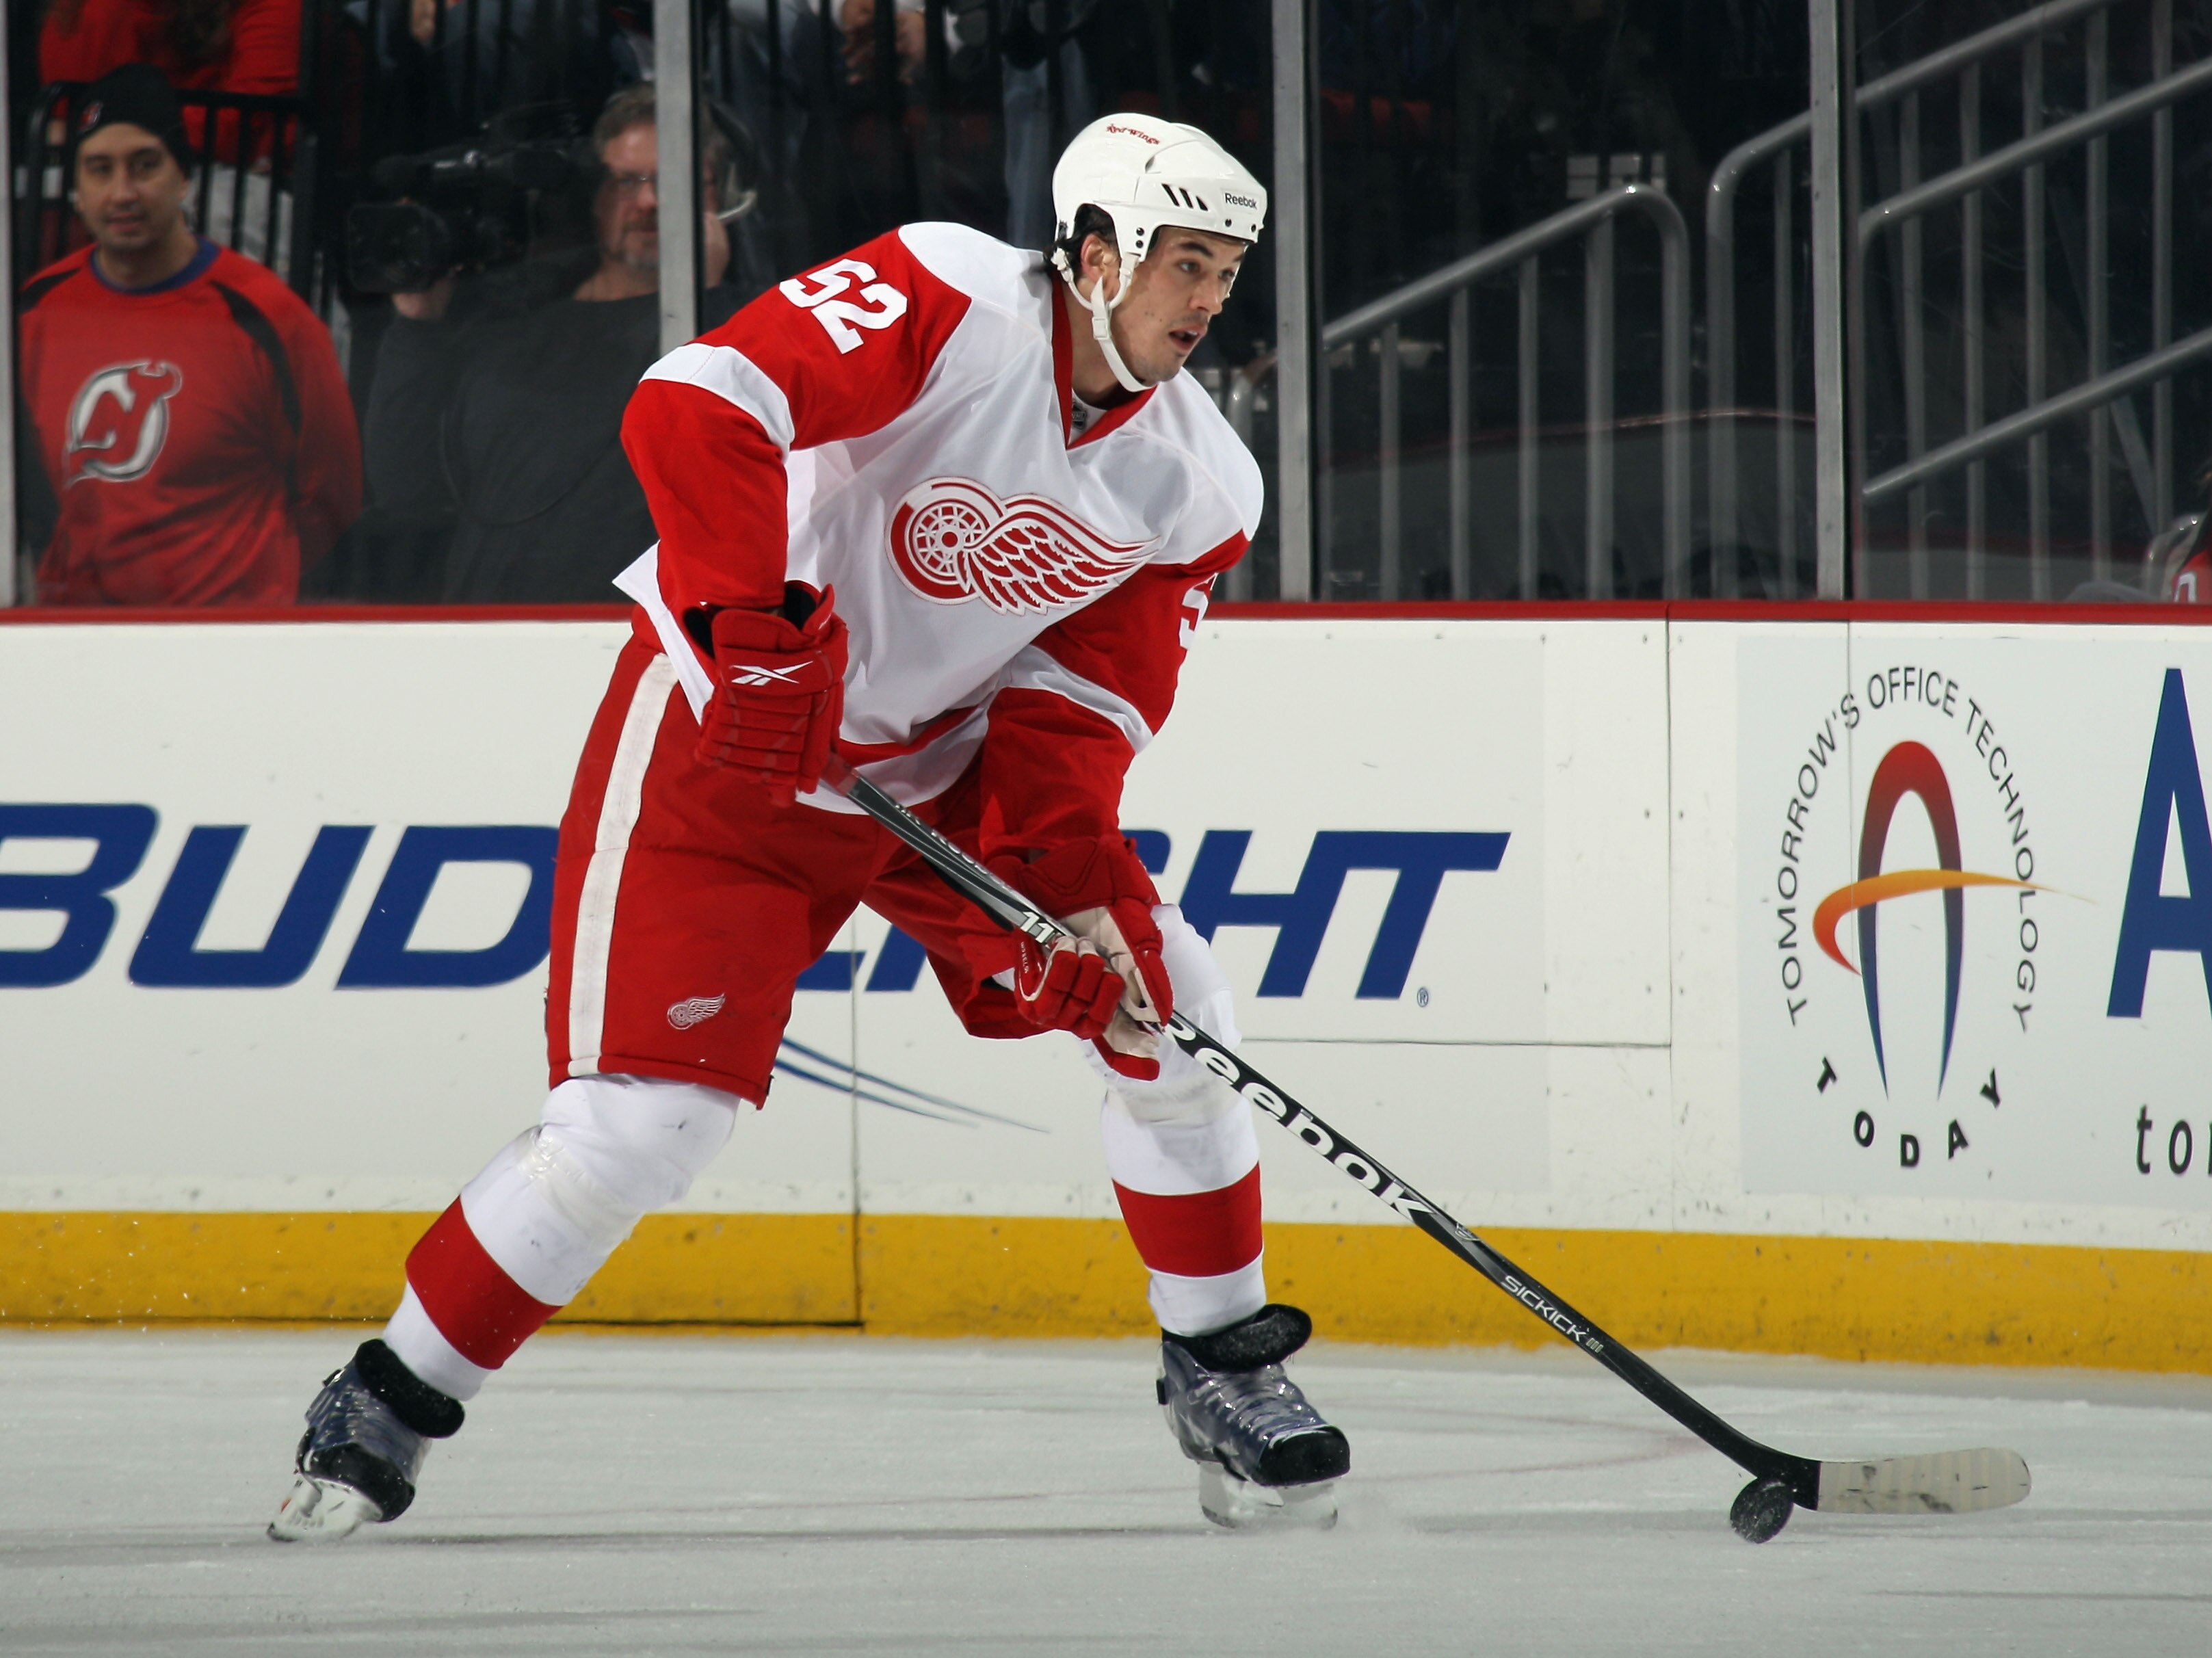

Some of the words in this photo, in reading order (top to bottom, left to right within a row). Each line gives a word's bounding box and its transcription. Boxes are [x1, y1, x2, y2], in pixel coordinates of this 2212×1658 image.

[1127, 128, 1161, 145] Wings
[1224, 192, 1258, 210] Reebok
[778, 258, 908, 355] 52
[1178, 573, 1219, 650] 5
[1775, 692, 1861, 1027] TOMORROW'S
[1867, 666, 1960, 720] OFFICE
[1964, 696, 2041, 1034] TECHNOLOGY
[0, 801, 559, 990] BUD
[1163, 1016, 1436, 1221] Reebok
[1816, 1055, 2002, 1169] TODAY
[2136, 1103, 2212, 1176] to
[1501, 1274, 1587, 1343] SICKICK
